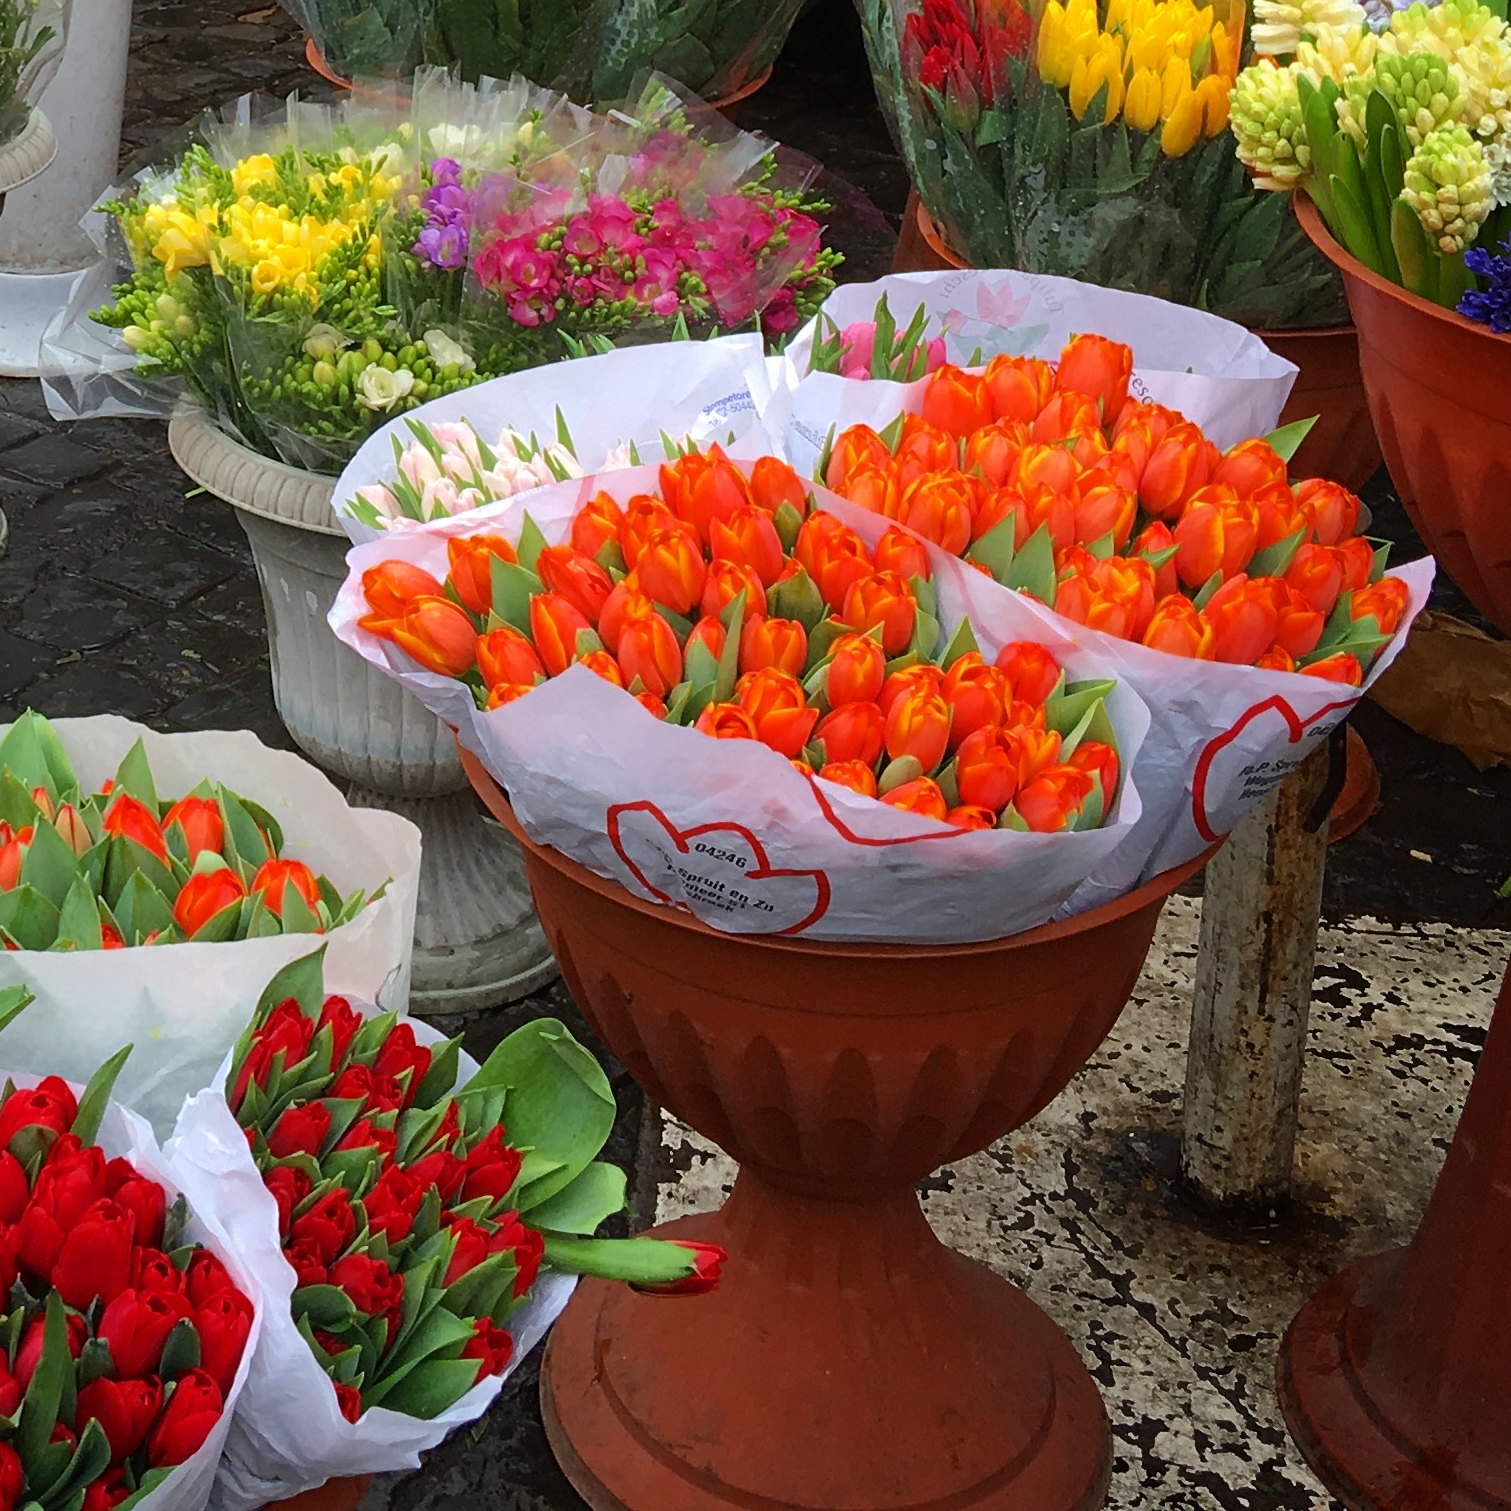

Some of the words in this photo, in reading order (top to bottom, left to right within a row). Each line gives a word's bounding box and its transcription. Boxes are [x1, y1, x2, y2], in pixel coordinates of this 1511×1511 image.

[694, 843, 747, 868] 04246
[730, 890, 749, 903] en
[753, 898, 774, 912] Zn
